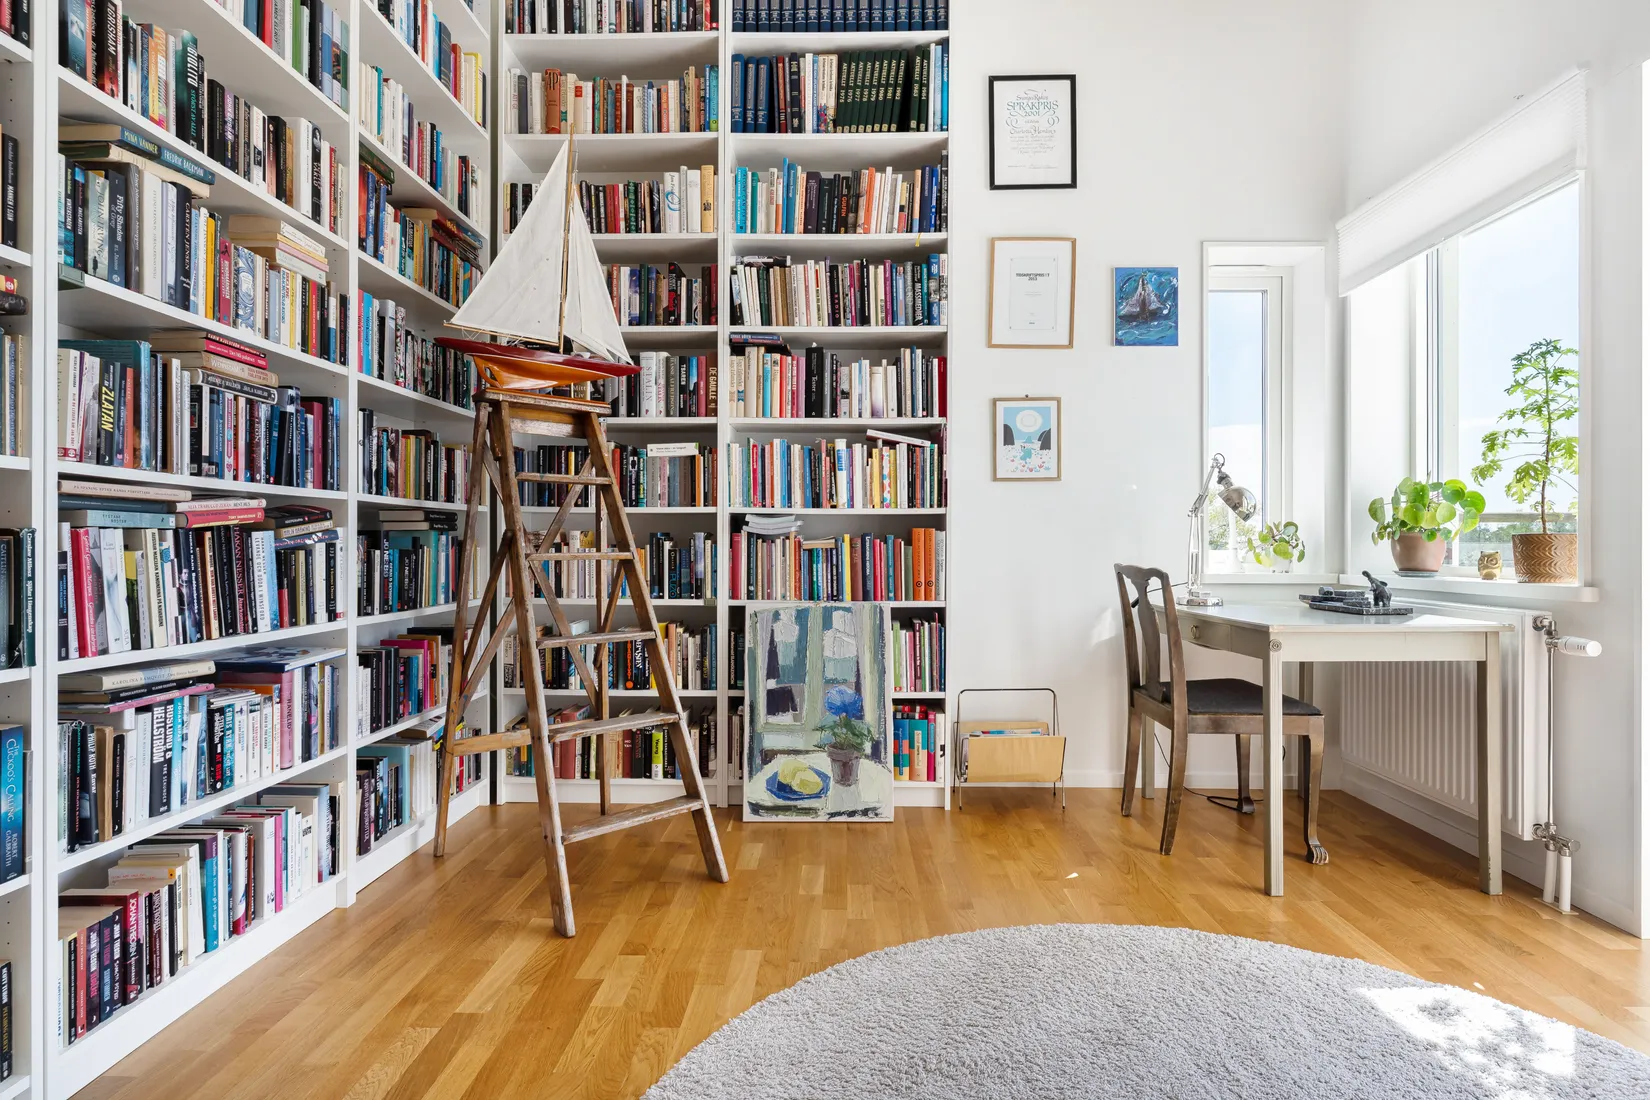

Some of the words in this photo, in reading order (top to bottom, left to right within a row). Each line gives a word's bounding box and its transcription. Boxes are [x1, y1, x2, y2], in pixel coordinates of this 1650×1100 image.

[107, 7, 117, 56] GRISHAM
[187, 46, 198, 88] GIOLITO
[856, 61, 864, 86] AKTUELLT
[864, 61, 872, 86] AKTUELLT
[872, 60, 880, 85] AKTUELLT
[880, 59, 888, 84] AKTUELLT
[889, 59, 897, 84] AKTUELLT
[897, 59, 905, 84] AKTUELLT
[124, 130, 139, 145] MINA
[164, 150, 183, 167] FREDRIK
[183, 157, 204, 177] BACKMAN
[6, 184, 14, 205] MANNEN
[96, 192, 105, 220] JOHN
[115, 194, 124, 214] Fifty
[109, 212, 117, 229] Grey
[110, 204, 117, 212] of
[96, 220, 105, 257] IRVING
[116, 214, 124, 242] Shades
[914, 282, 923, 321] MASSMEDIER
[645, 366, 653, 402] STALIN
[709, 367, 717, 376] DE
[709, 376, 717, 400] GAULLE
[101, 386, 115, 432] ZLATAN
[150, 532, 158, 551] ALISTAIR
[233, 526, 242, 559] HÅKAN
[254, 537, 262, 560] LEVANDE
[383, 538, 389, 550] JO
[152, 550, 160, 571] MACLEAN
[255, 561, 263, 573] OCH
[236, 560, 244, 595] NESSER
[668, 573, 677, 598] PUZO
[191, 572, 199, 614] Buddenbrooks
[25, 599, 34, 633] fångenskap
[157, 605, 165, 628] NAVARONE
[111, 677, 139, 686] KAROLINA
[213, 712, 221, 744] RIMINGTON
[225, 707, 233, 729] CHRIS
[88, 733, 97, 753] PHILIP
[152, 706, 167, 764] HELLSTRÖM
[88, 753, 97, 770] ROTH
[215, 754, 222, 762] AT
[5, 784, 17, 823] CALLING
[129, 898, 138, 926] JOHAN
[90, 931, 98, 949] JOHAN
[103, 927, 111, 943] JOHAN
[113, 923, 121, 940] JOHAN
[129, 925, 138, 958] THEORIN
[90, 949, 98, 973] THEORIN
[103, 943, 111, 966] THEORIN
[113, 939, 121, 961] THEORIN
